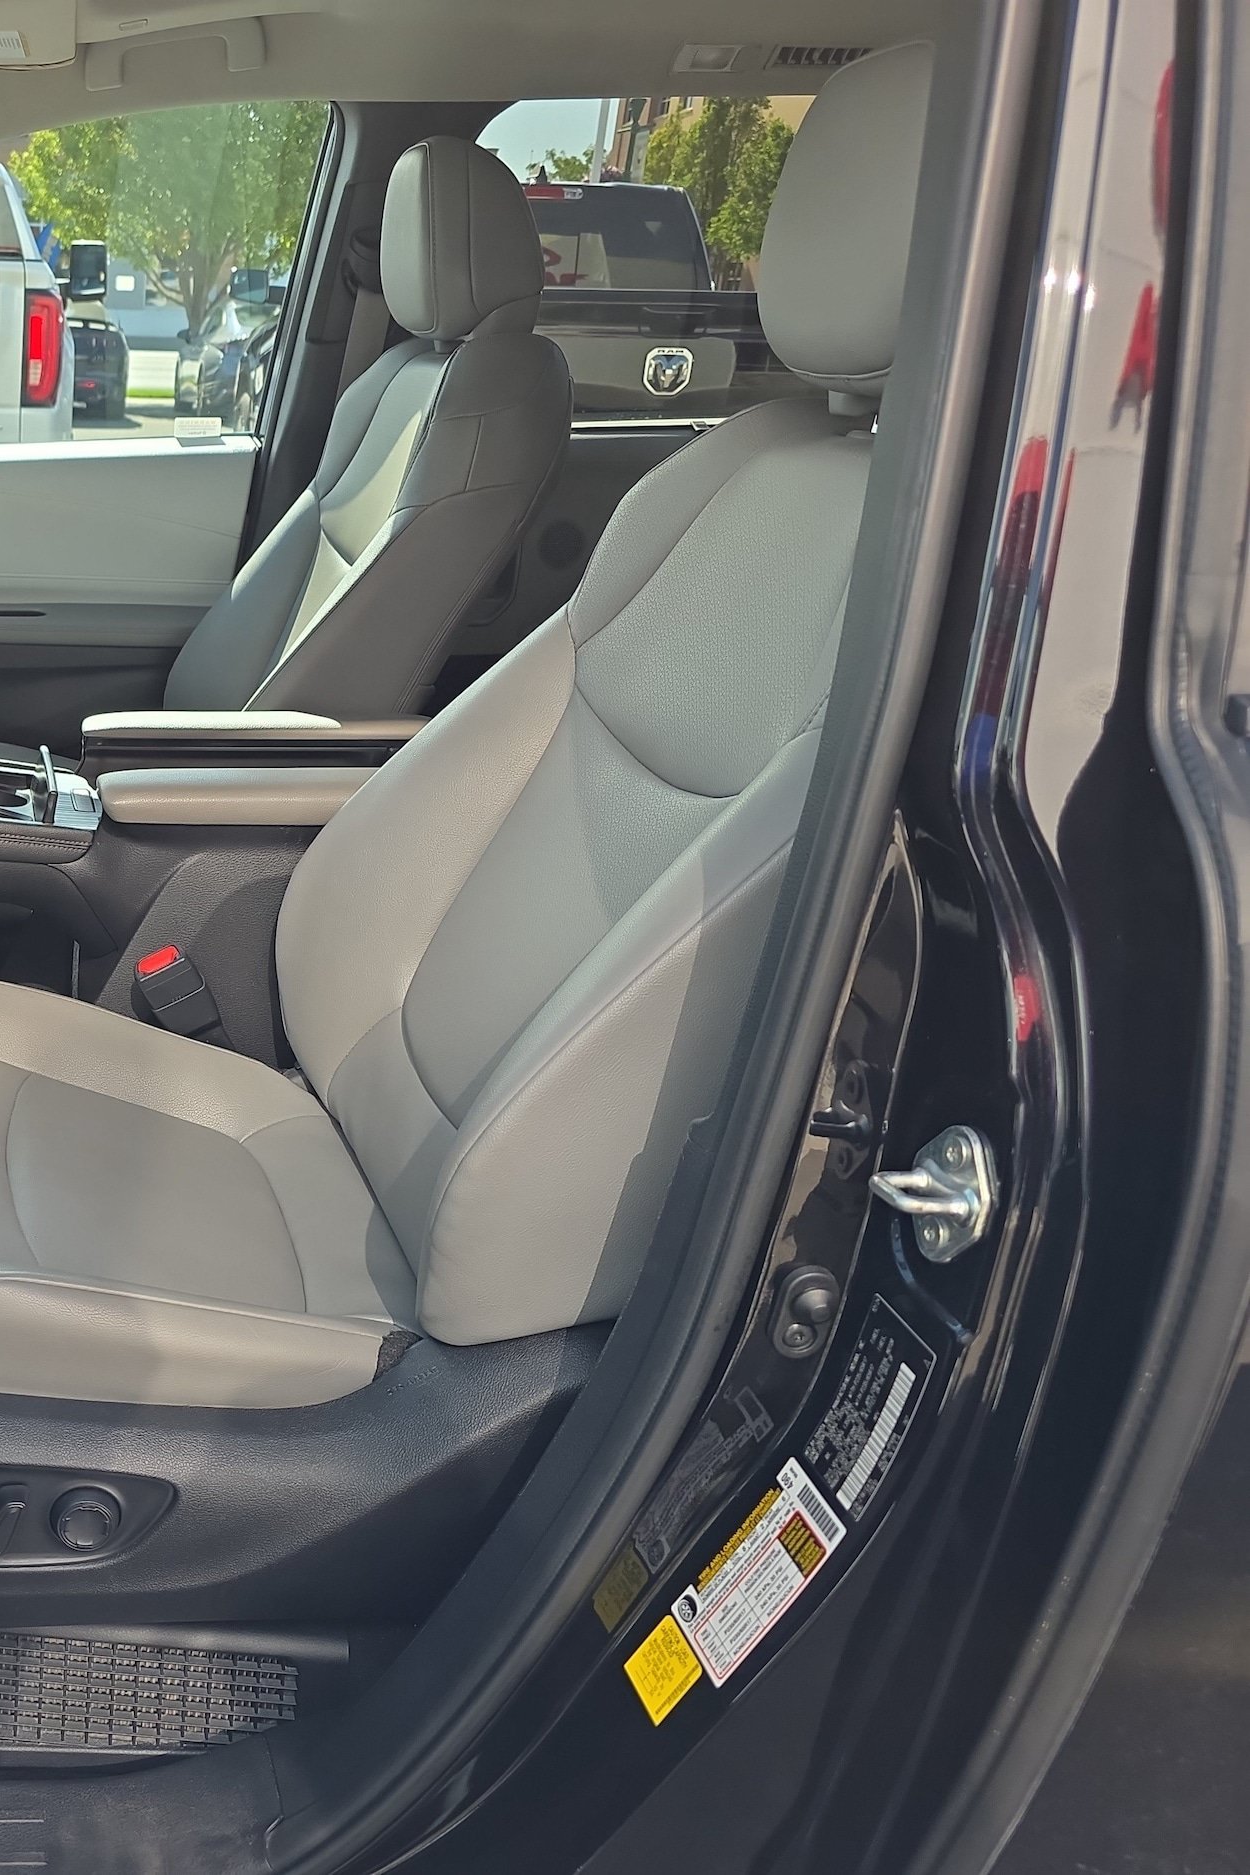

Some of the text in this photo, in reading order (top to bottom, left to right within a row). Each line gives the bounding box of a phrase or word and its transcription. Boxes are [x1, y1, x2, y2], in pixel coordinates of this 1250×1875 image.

[780, 1472, 794, 1490] 490
[697, 1564, 711, 1582] TIRE
[708, 1551, 722, 1569] AND
[719, 1526, 742, 1556] LOADING
[740, 1486, 775, 1530] INFORMATION
